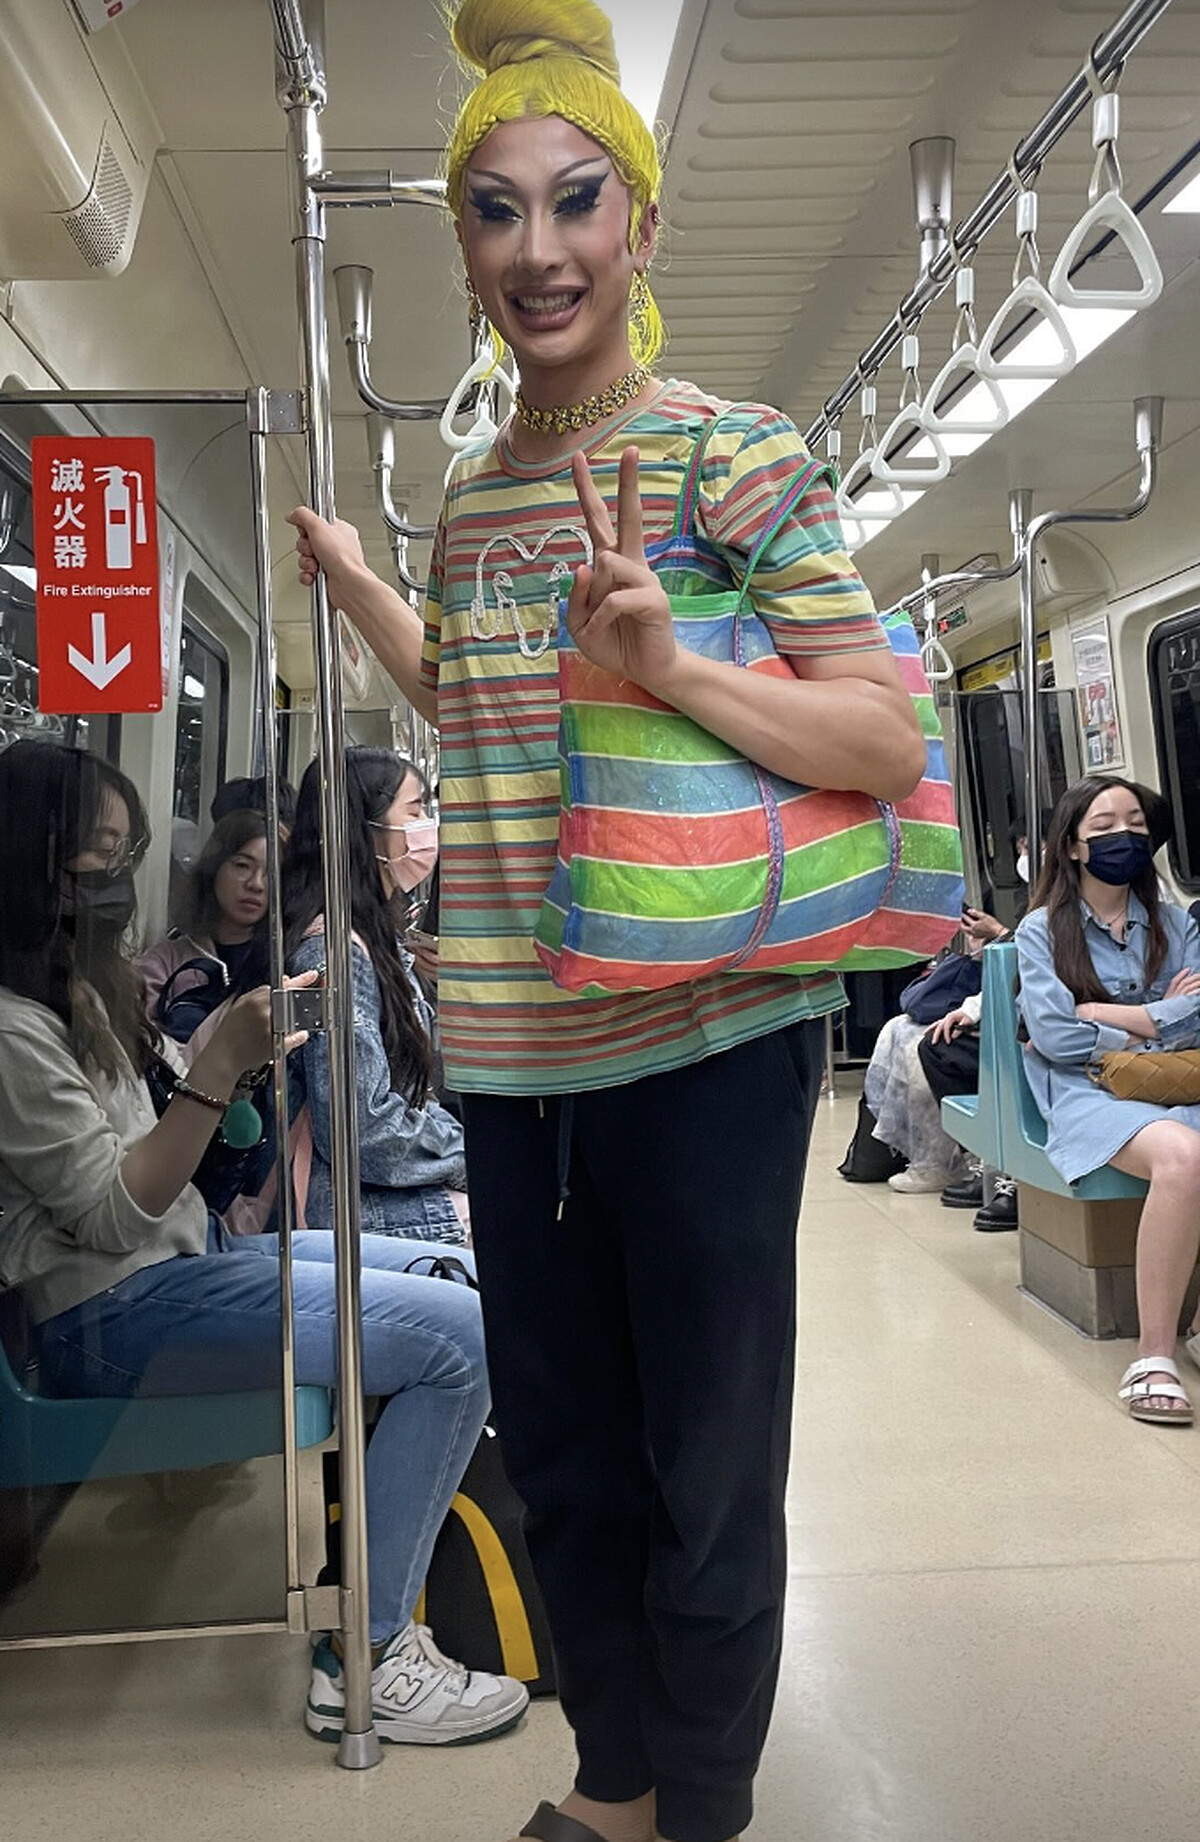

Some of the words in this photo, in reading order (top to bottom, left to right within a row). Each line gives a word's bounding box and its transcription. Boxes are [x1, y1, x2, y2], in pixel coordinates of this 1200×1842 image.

[50, 458, 87, 569] 滅火器
[43, 585, 68, 596] Fire
[71, 584, 152, 598] Extinguisher
[381, 1673, 423, 1706] N
